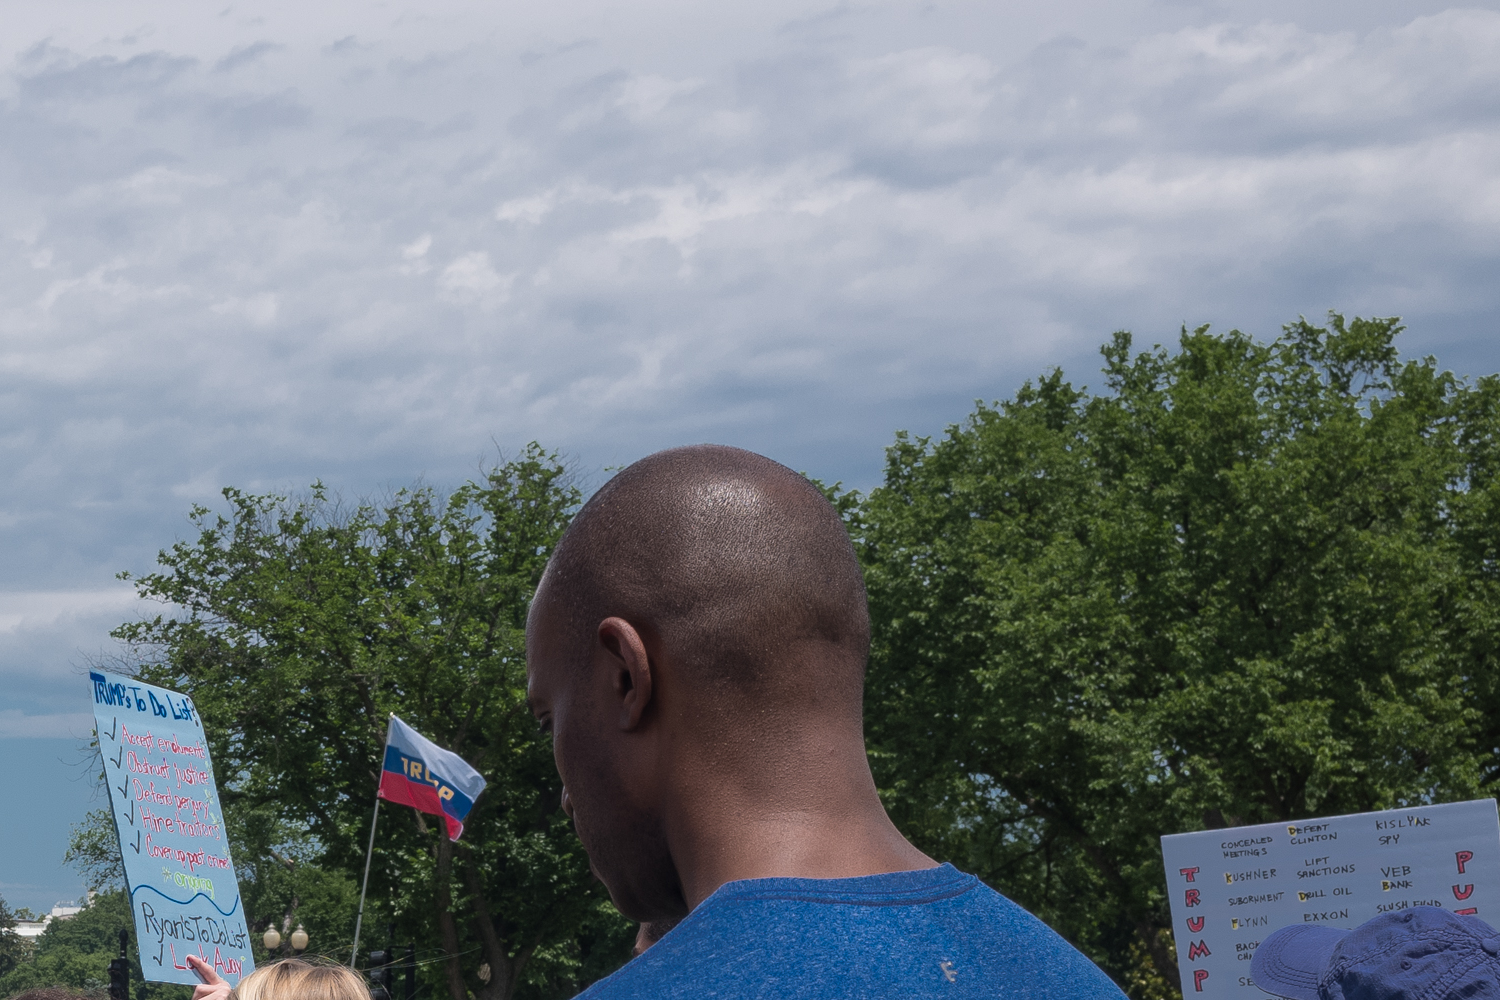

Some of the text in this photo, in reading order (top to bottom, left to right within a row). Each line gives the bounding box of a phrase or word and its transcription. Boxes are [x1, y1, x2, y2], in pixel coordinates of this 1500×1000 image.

[128, 687, 146, 712] To
[148, 690, 167, 718] Do
[121, 723, 154, 754] Accept
[173, 762, 210, 790] justice
[132, 778, 210, 820] Defend perjury
[139, 806, 220, 840] Hire traitors
[1288, 824, 1330, 836] DEFEAT
[1221, 836, 1273, 849] CONCEALED
[1290, 832, 1338, 845] CLINTON
[1378, 834, 1400, 845] SPY
[145, 833, 173, 860] Cover
[1223, 848, 1268, 859] MEETINGS
[1305, 856, 1330, 867] LIFT
[1225, 868, 1277, 883] KUSHNER
[1297, 864, 1356, 879] SANCTIONS
[1380, 865, 1411, 878] VEB
[1381, 880, 1413, 891] BANK
[1298, 887, 1352, 901] DRILL OIL
[1376, 900, 1409, 913] SLUSH
[1232, 915, 1268, 929] FLYNN
[1303, 908, 1349, 922] EXXON
[189, 916, 209, 943] To
[206, 917, 226, 945] Do
[222, 919, 246, 949] List
[1179, 867, 1211, 992] TRUMP
